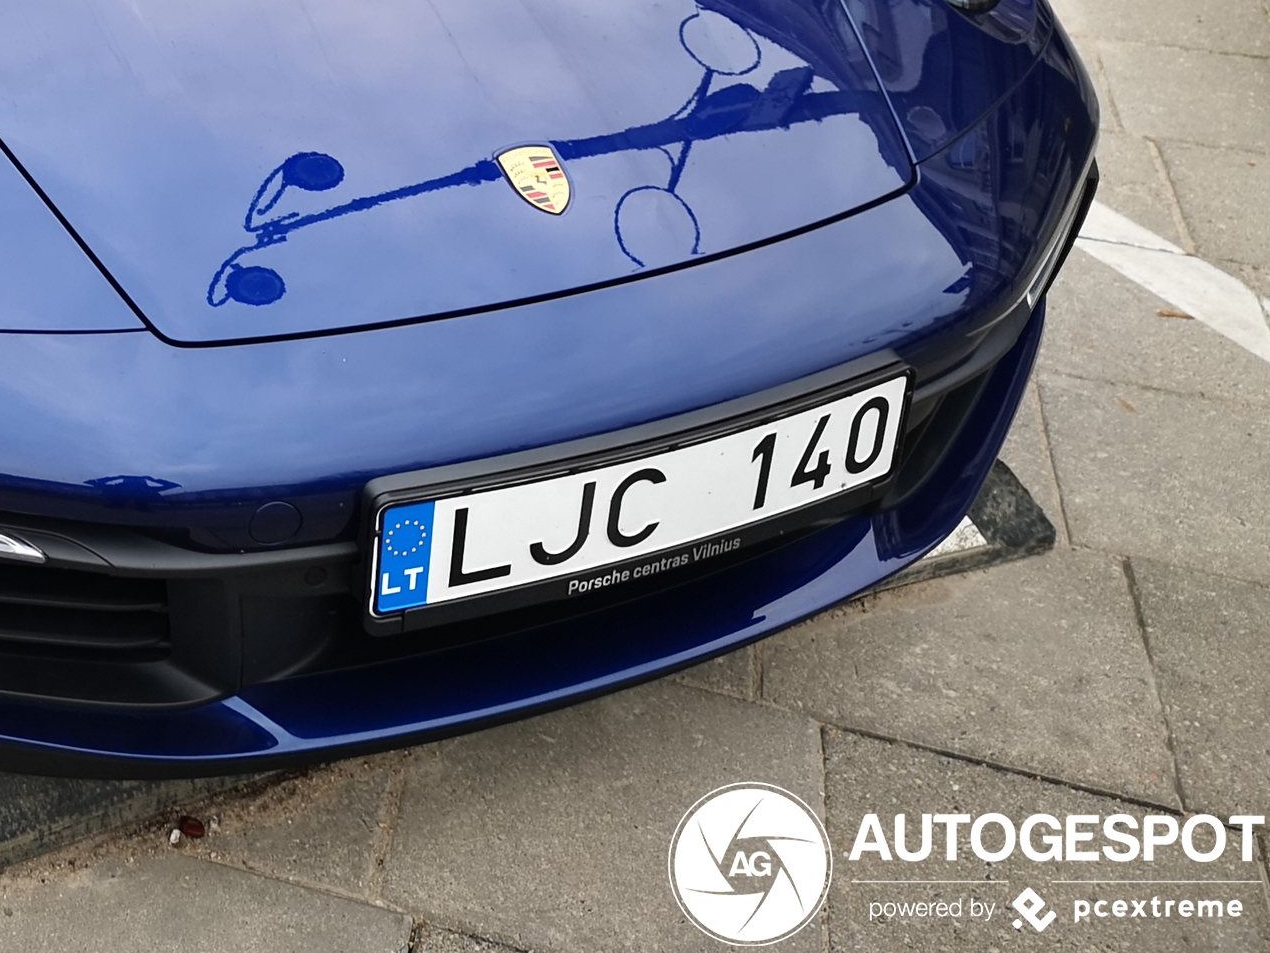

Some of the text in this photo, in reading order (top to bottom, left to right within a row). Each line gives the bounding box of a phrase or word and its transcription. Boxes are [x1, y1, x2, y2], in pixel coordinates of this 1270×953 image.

[448, 396, 890, 588] LJC 140
[381, 566, 425, 595] LT
[567, 536, 742, 596] Porsche centras Vilnius
